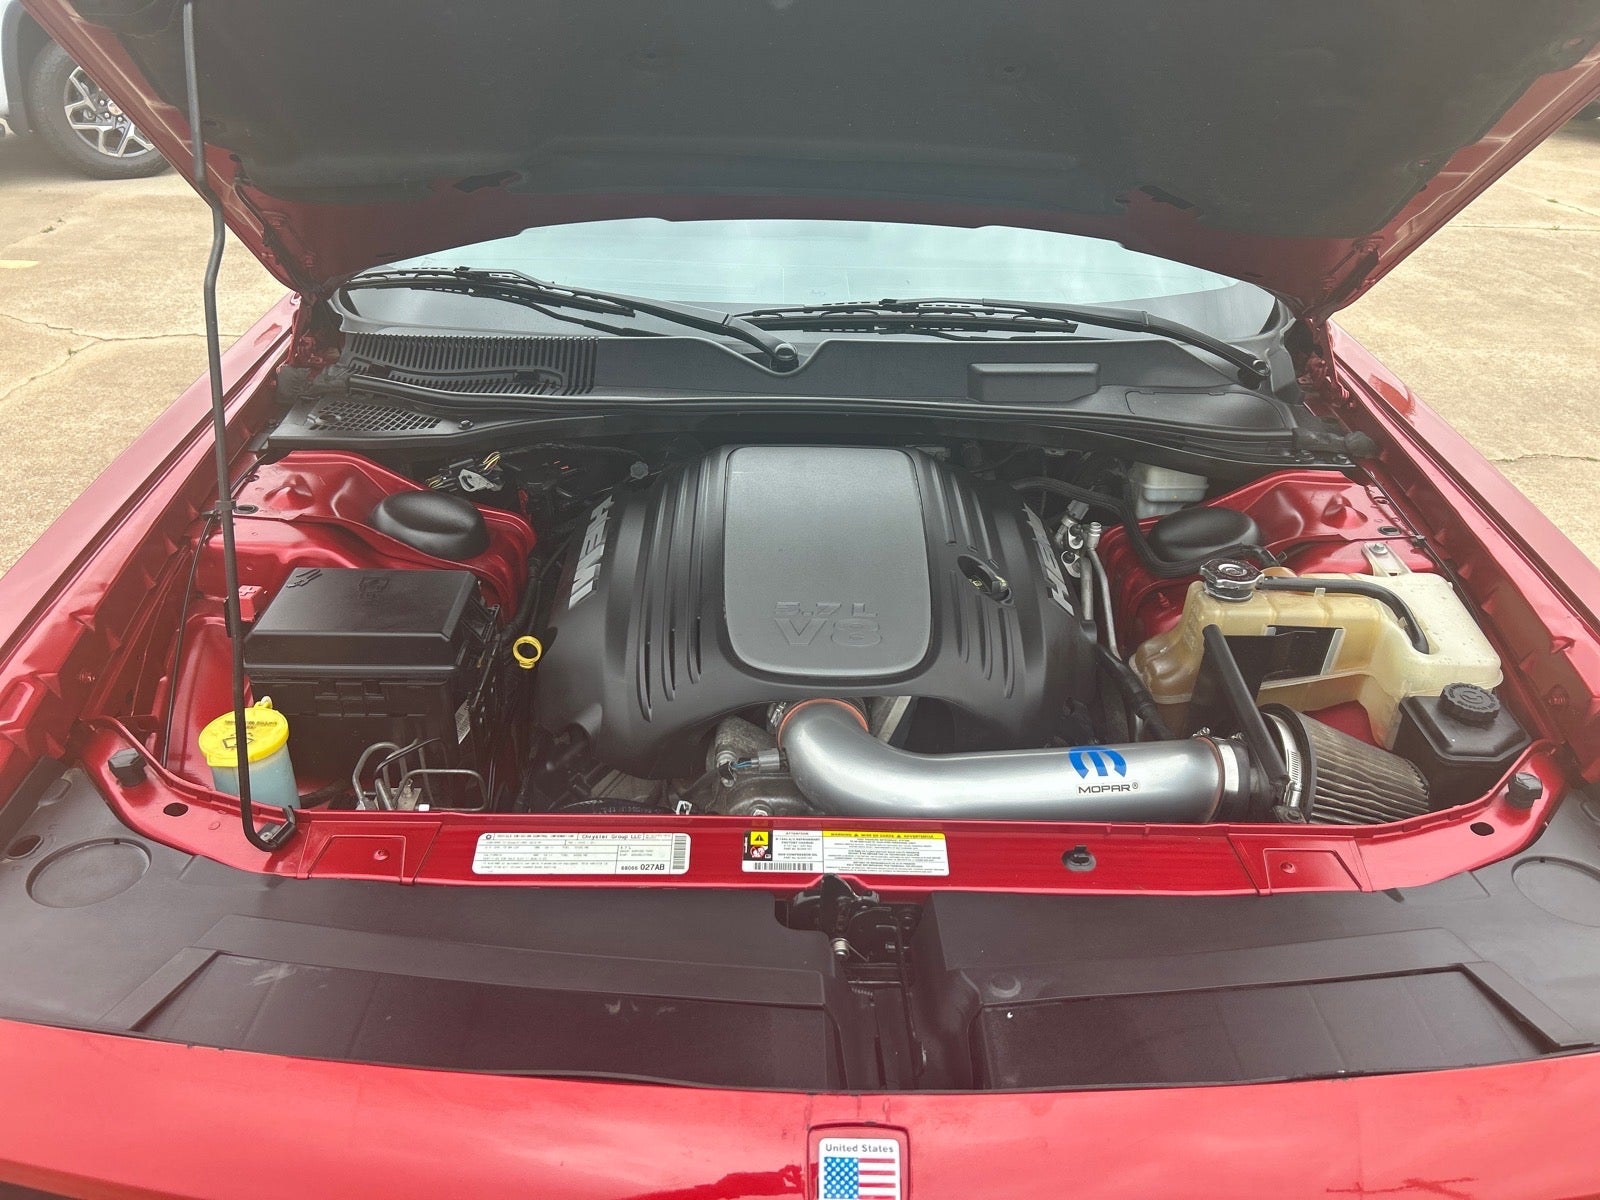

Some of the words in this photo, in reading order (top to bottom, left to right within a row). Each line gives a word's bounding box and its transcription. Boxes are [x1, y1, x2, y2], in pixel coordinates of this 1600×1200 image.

[568, 495, 614, 610] HEMI
[774, 618, 883, 648] V8
[640, 863, 665, 871] 027AB
[825, 1143, 859, 1152] United
[861, 1143, 894, 1153] States
